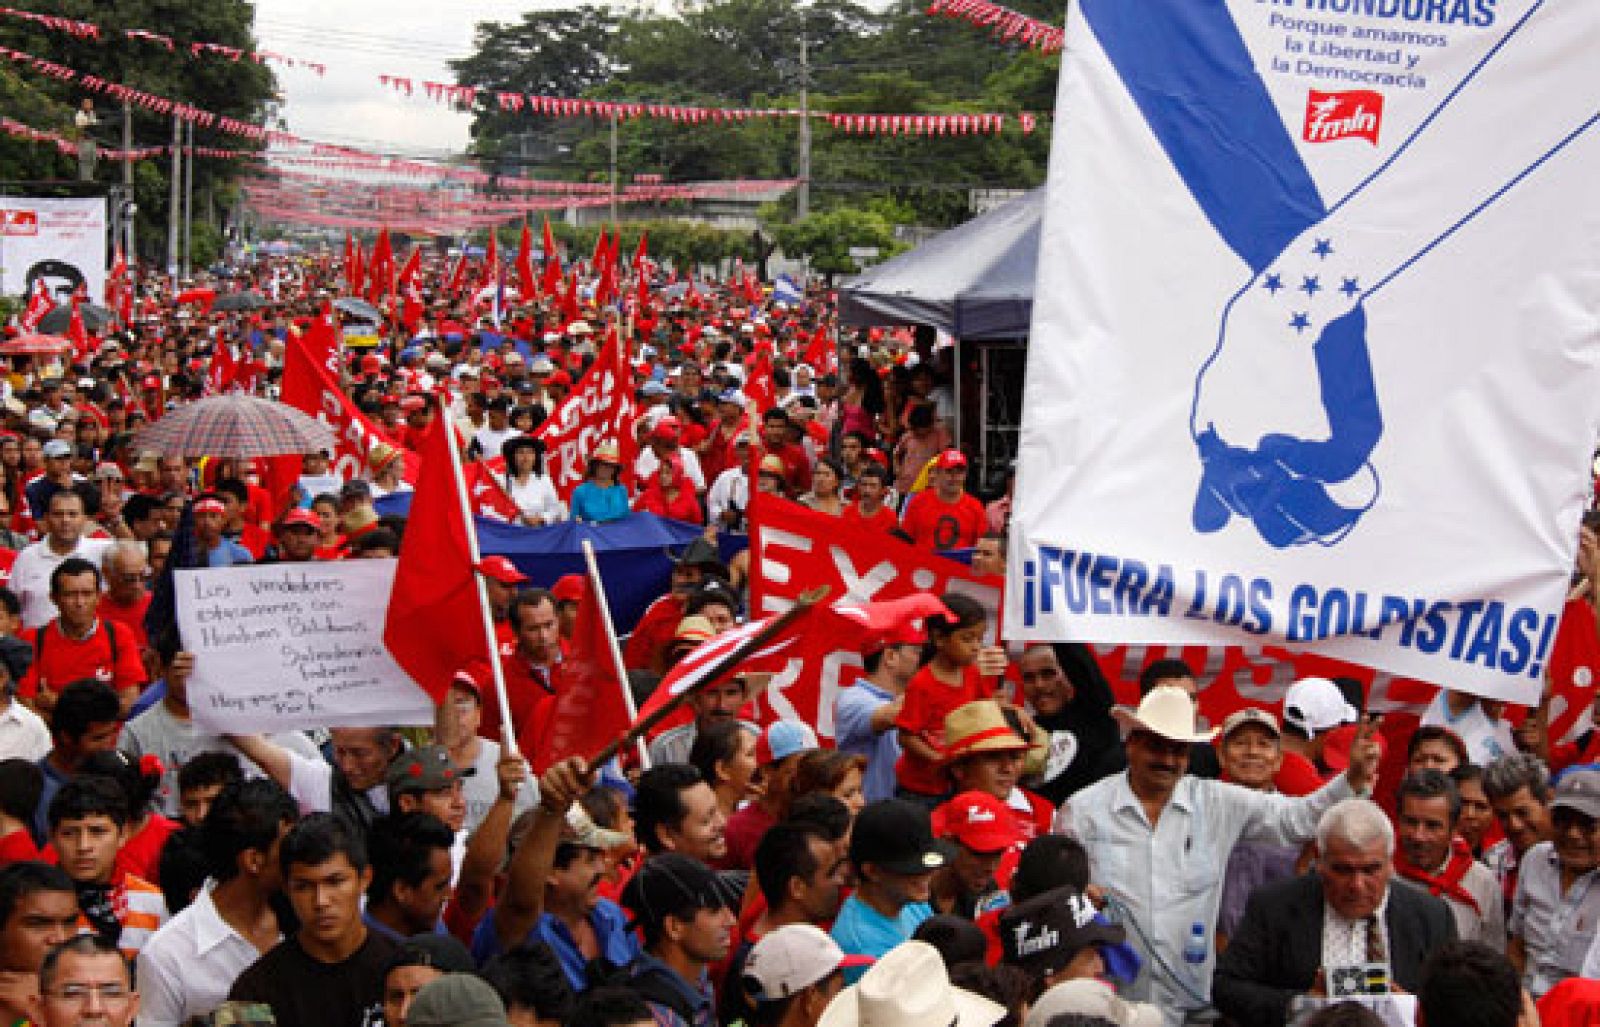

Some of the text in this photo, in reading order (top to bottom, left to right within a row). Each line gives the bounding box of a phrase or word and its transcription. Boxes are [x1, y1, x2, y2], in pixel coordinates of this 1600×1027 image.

[1268, 12, 1447, 48] Porque amamos
[1285, 36, 1420, 69] la Libertad y
[1271, 55, 1426, 88] la Democracia
[1023, 546, 1173, 628] ¡FUERA
[1184, 570, 1273, 635] LOS
[1285, 585, 1557, 678] GOLPISTAS!
